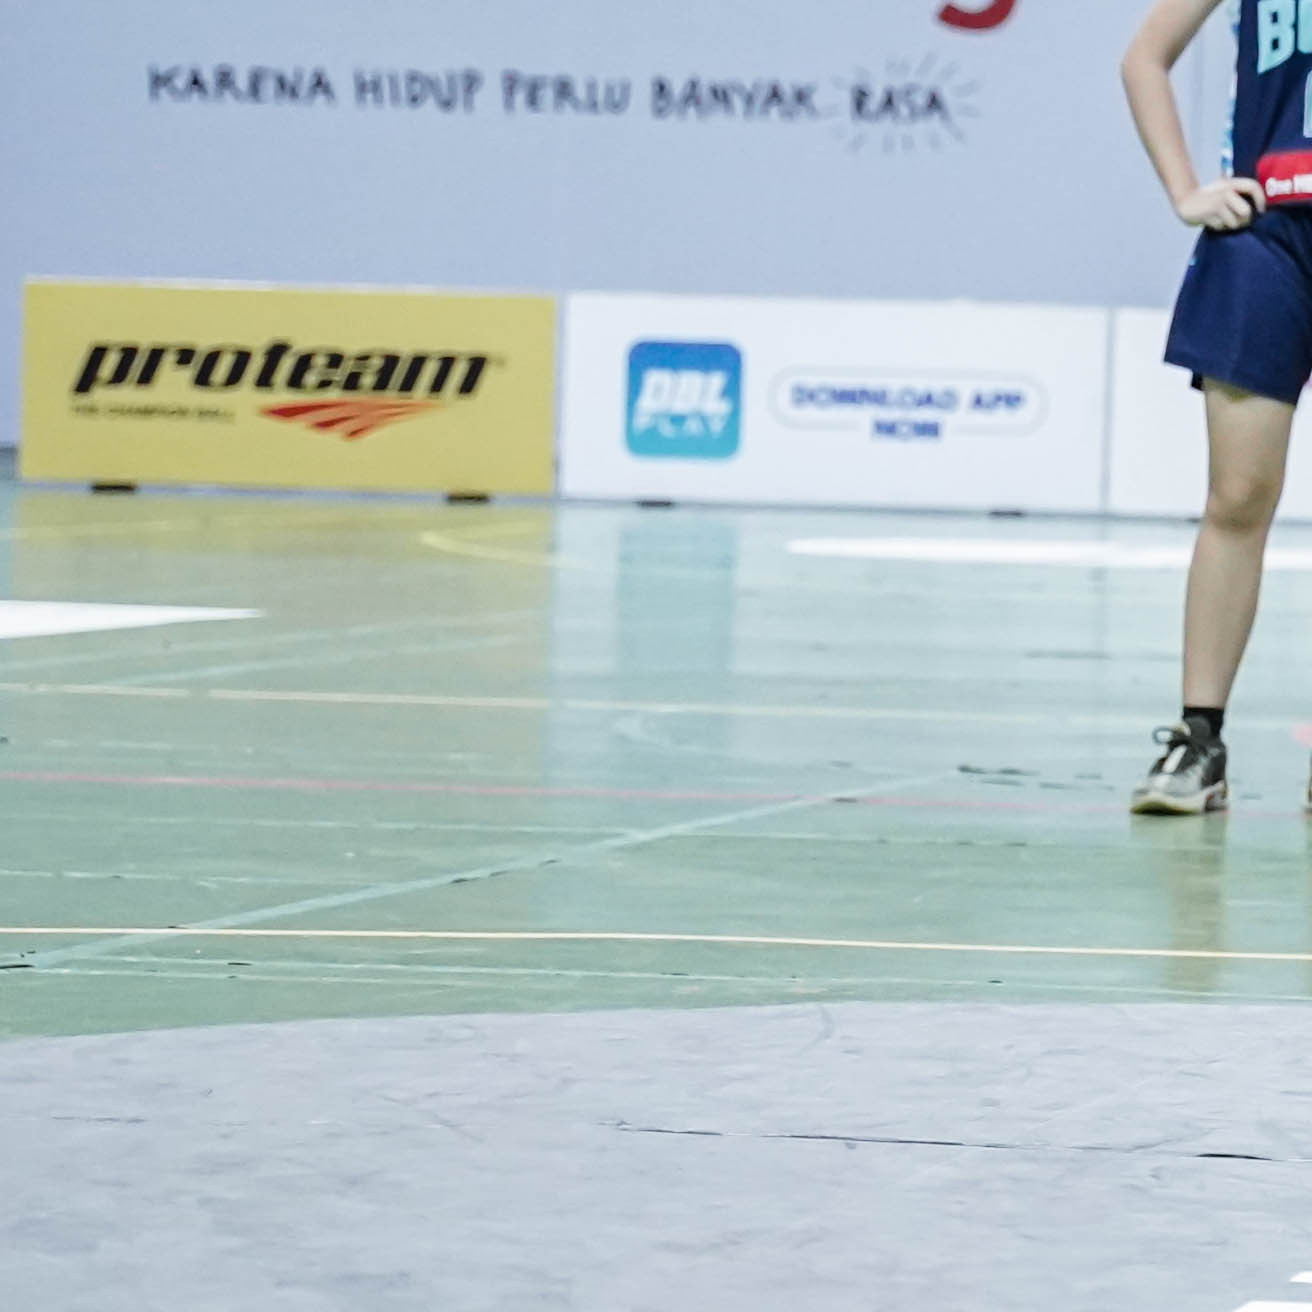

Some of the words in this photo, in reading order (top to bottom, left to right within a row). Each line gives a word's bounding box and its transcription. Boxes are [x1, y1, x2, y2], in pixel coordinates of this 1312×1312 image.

[148, 63, 335, 106] KARENA
[352, 67, 483, 113] HIDUP
[503, 72, 631, 116] PERLU
[650, 77, 822, 121] BANYAK
[850, 86, 952, 127] RASA
[71, 338, 490, 399] proteam
[789, 383, 959, 411] DOWNLOAD
[967, 388, 1027, 412] APP
